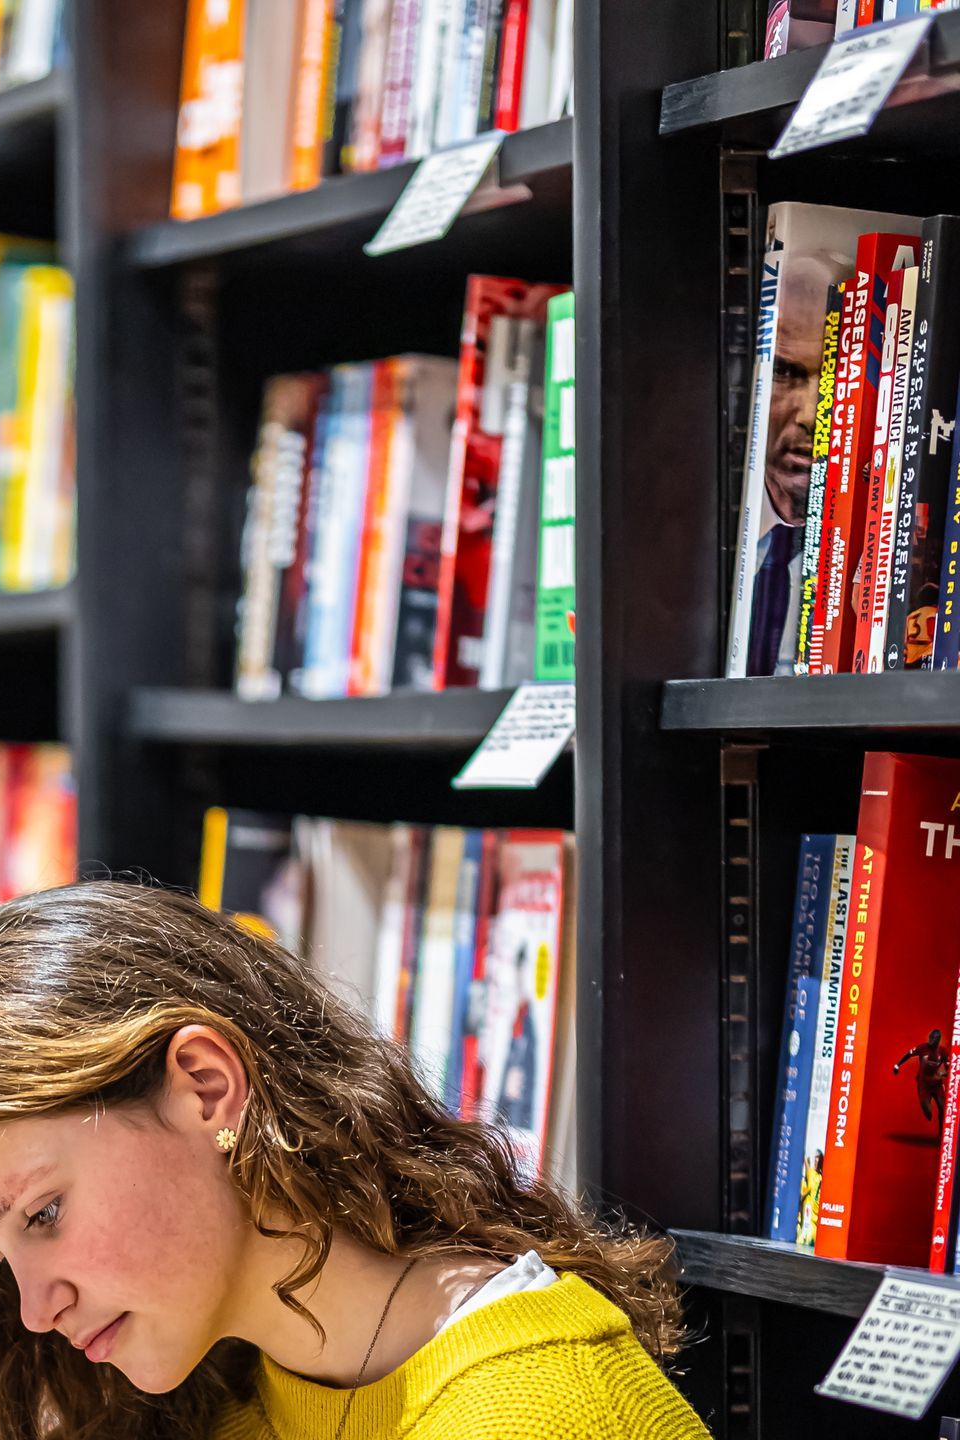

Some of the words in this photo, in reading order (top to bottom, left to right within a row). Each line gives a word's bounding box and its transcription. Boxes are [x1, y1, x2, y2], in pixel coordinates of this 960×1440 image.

[756, 260, 779, 362] ZIDANE
[898, 309, 912, 345] AMY
[846, 271, 869, 398] ARSENAL
[825, 312, 840, 410] BUILDING
[913, 320, 928, 409] STUCK
[847, 404, 855, 425] ON
[889, 354, 908, 447] LAWRENCE
[907, 379, 916, 434] BALLAD
[820, 414, 832, 456] THE
[843, 428, 854, 458] THE
[908, 425, 919, 456] IN
[841, 460, 851, 493] EDGE
[871, 475, 880, 512] AMY
[832, 527, 840, 564] KEVIN
[837, 539, 845, 570] ALEX
[896, 494, 913, 602] MOMENT
[861, 521, 878, 622] LAWRENCE
[873, 511, 893, 629] INVINCIBLE
[944, 541, 958, 633] BURNS
[798, 604, 811, 652] Hesse
[810, 855, 821, 899] 100
[840, 846, 850, 871] THE
[861, 846, 873, 872] AT
[834, 878, 850, 930] LAST
[856, 879, 871, 923] THE
[852, 931, 865, 978] END
[799, 990, 808, 1020] OF
[822, 935, 845, 1058] CHAMPIONS
[849, 984, 860, 1016] OF
[843, 1021, 856, 1064] THE
[835, 1069, 852, 1147] STORM
[945, 1053, 957, 1123] ANALYTICS
[945, 1114, 957, 1159] Liverpool
[937, 1128, 951, 1210] REVOLUTION
